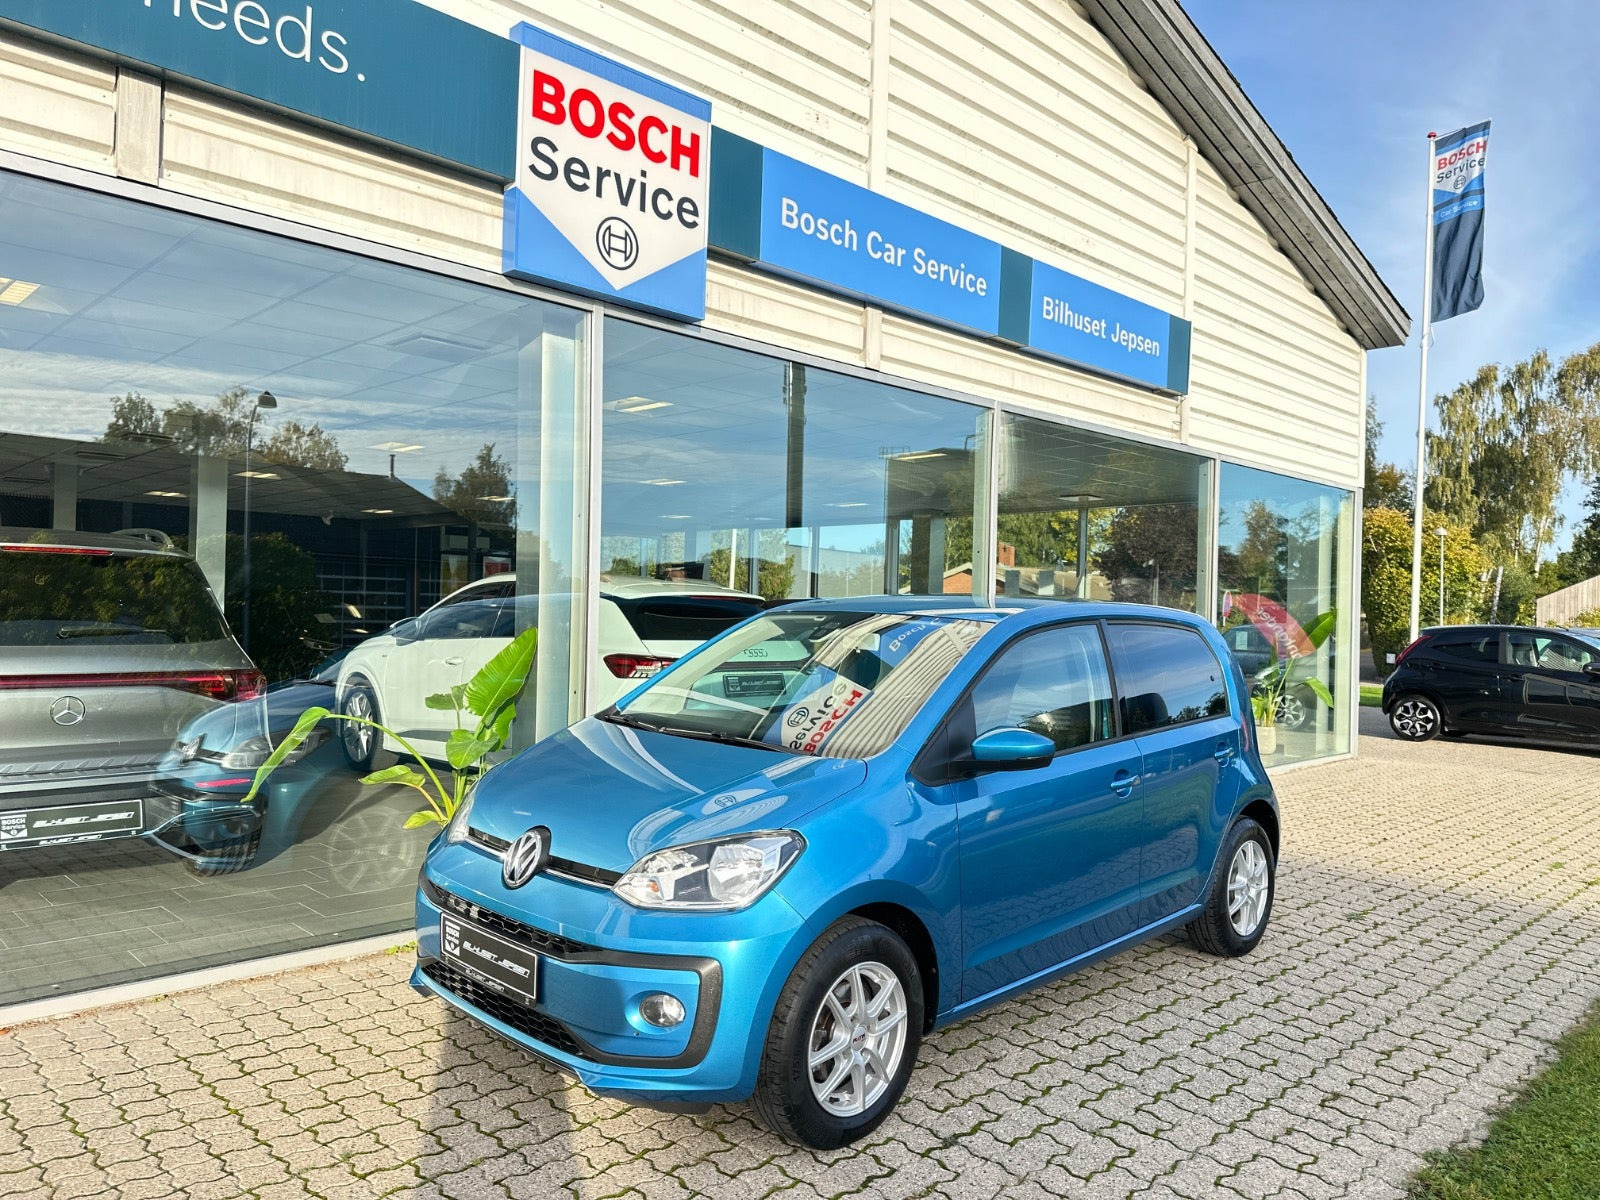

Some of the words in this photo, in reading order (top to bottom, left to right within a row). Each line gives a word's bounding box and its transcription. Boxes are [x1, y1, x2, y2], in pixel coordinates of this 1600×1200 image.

[532, 69, 701, 178] BOSCH
[528, 136, 700, 229] Service
[1436, 157, 1485, 183] Service
[1437, 140, 1487, 171] BOSCH
[781, 196, 858, 252] Bosch
[866, 230, 906, 268] Car
[912, 247, 988, 297] Service
[1042, 295, 1107, 339] Bilhuset
[1110, 322, 1160, 357] Jepsen
[1, 817, 26, 825] BOSCH
